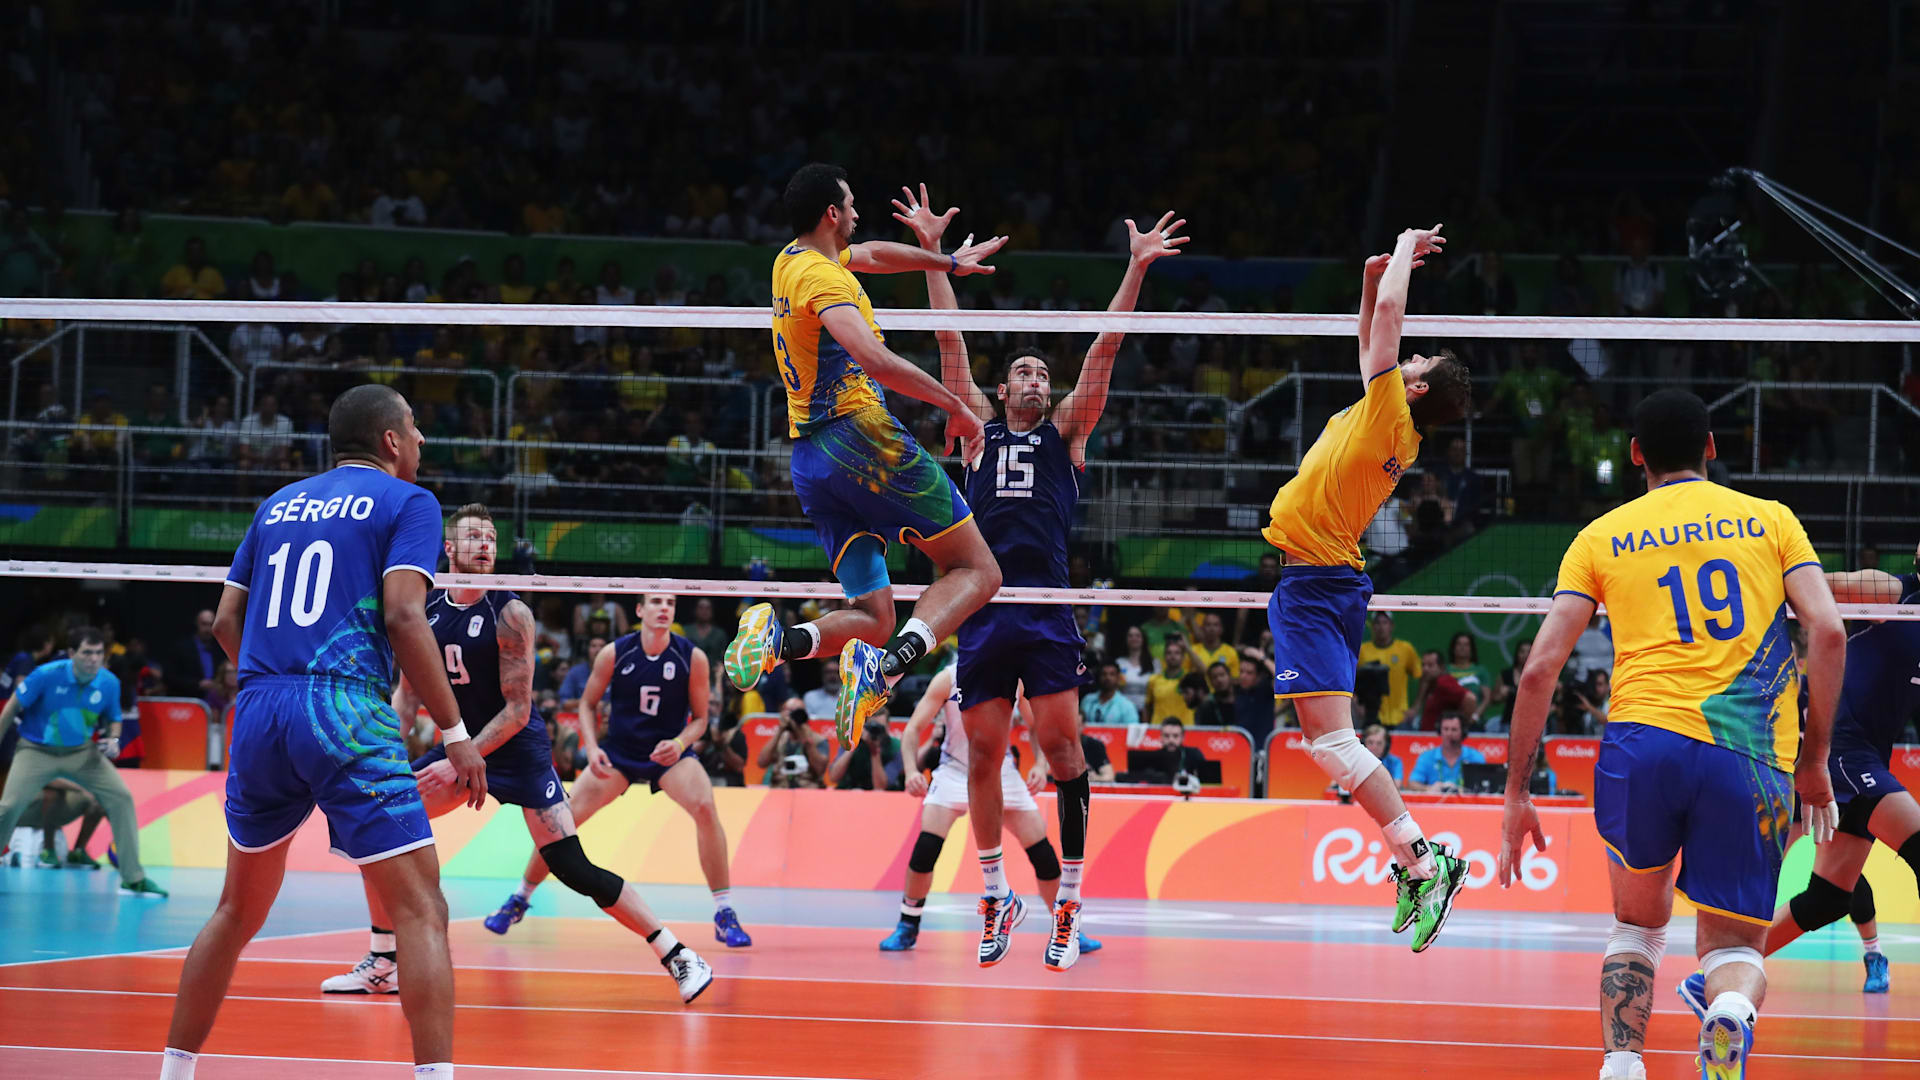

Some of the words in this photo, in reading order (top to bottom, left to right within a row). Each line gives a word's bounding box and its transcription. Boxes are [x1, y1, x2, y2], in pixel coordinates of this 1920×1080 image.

[777, 332, 800, 391] 3
[996, 445, 1035, 489] 15
[265, 492, 374, 525] SÉRGIO
[1611, 513, 1765, 557] MAURÍCIO
[266, 540, 334, 628] 10
[1657, 559, 1745, 643] 19
[445, 644, 470, 685] 9
[640, 685, 661, 716] 6
[1861, 773, 1876, 787] 5
